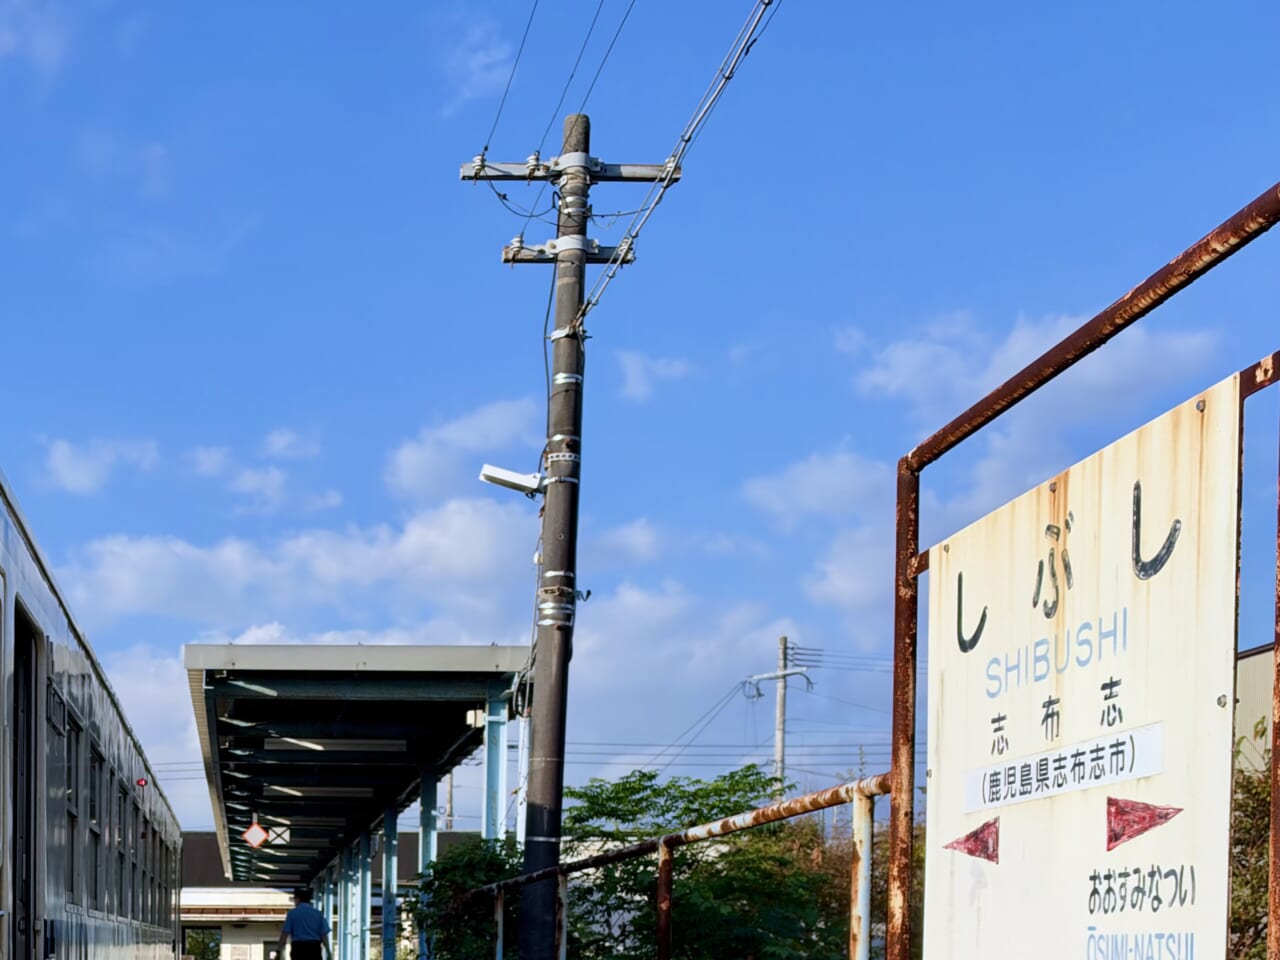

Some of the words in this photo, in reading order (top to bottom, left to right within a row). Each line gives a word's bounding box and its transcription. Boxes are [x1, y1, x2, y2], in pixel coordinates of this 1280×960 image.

[957, 480, 1181, 653] しぶし
[985, 607, 1128, 699] SHIBUSHI
[990, 676, 1123, 756] 志布志
[981, 734, 1136, 804] (鹿児島県志布志市)
[1088, 863, 1196, 915] おおすみなつい
